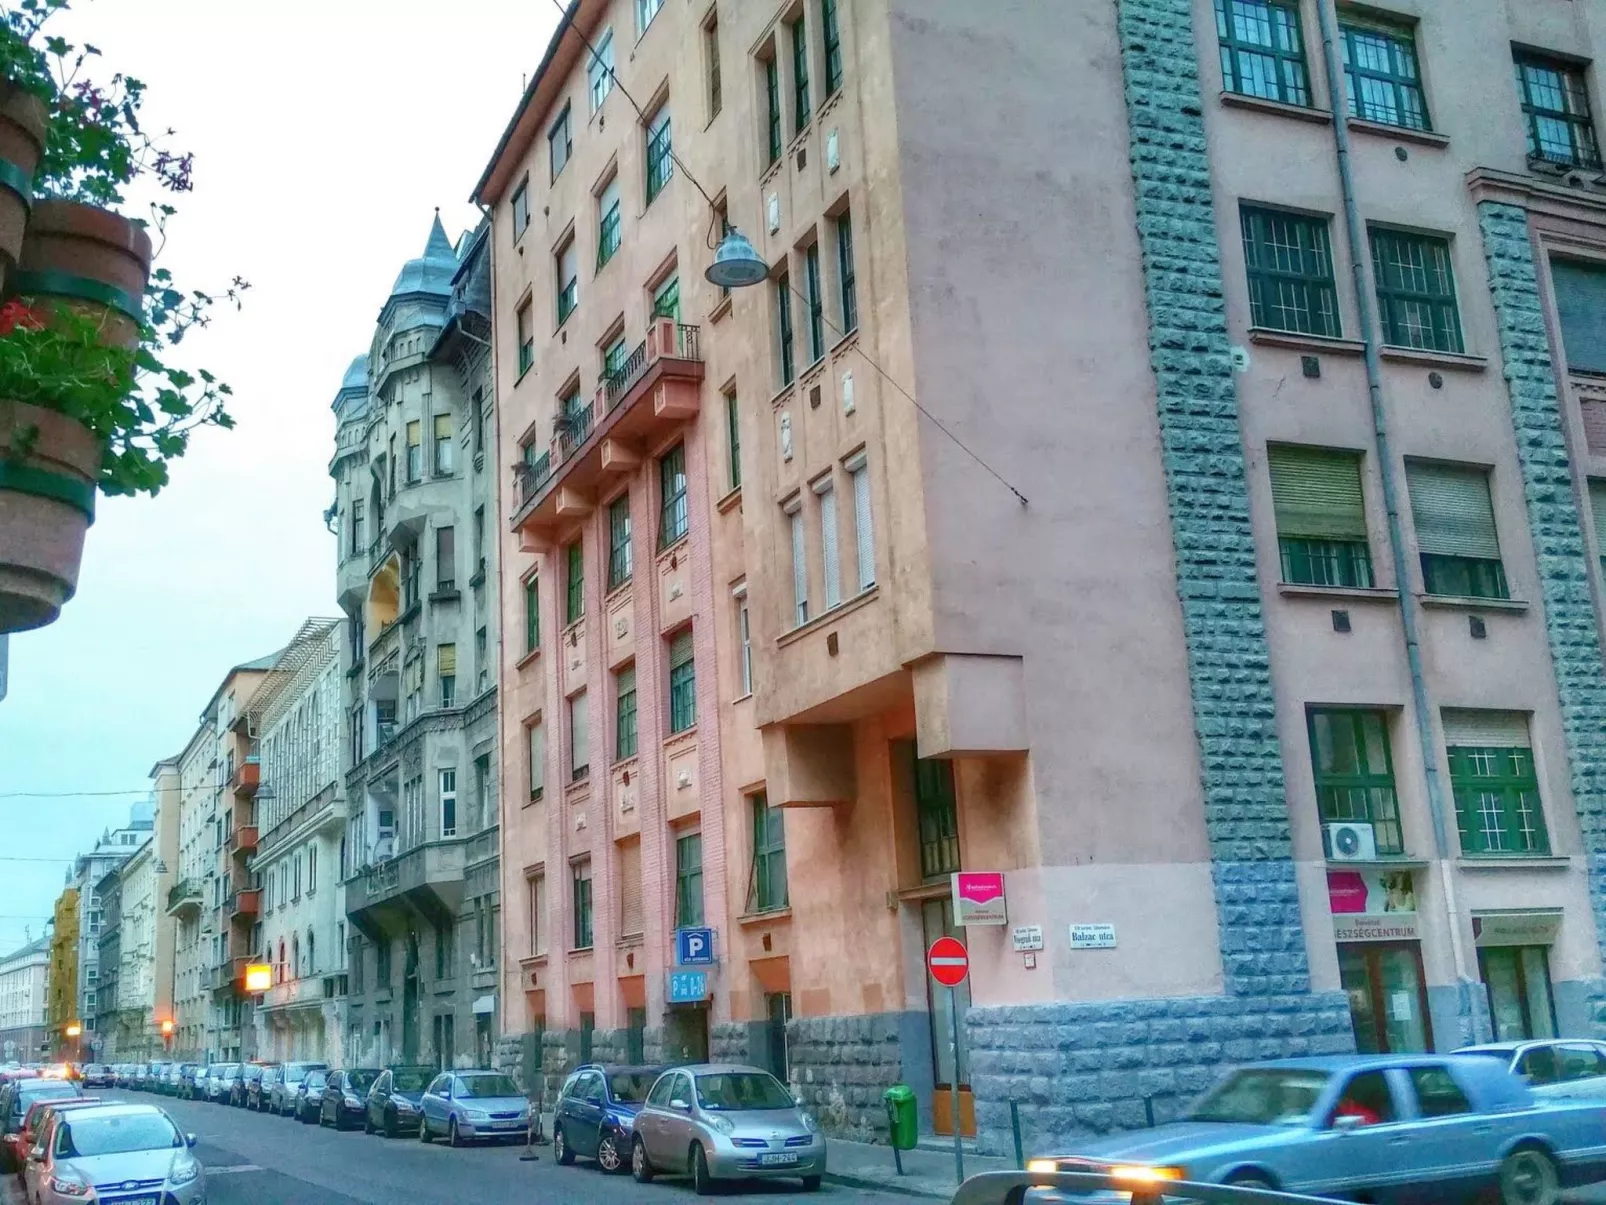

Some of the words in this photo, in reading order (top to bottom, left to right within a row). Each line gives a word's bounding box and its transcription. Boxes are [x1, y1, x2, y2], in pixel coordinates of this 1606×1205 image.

[1072, 932, 1096, 941] Balzac
[1099, 932, 1114, 940] utca
[689, 938, 704, 957] P
